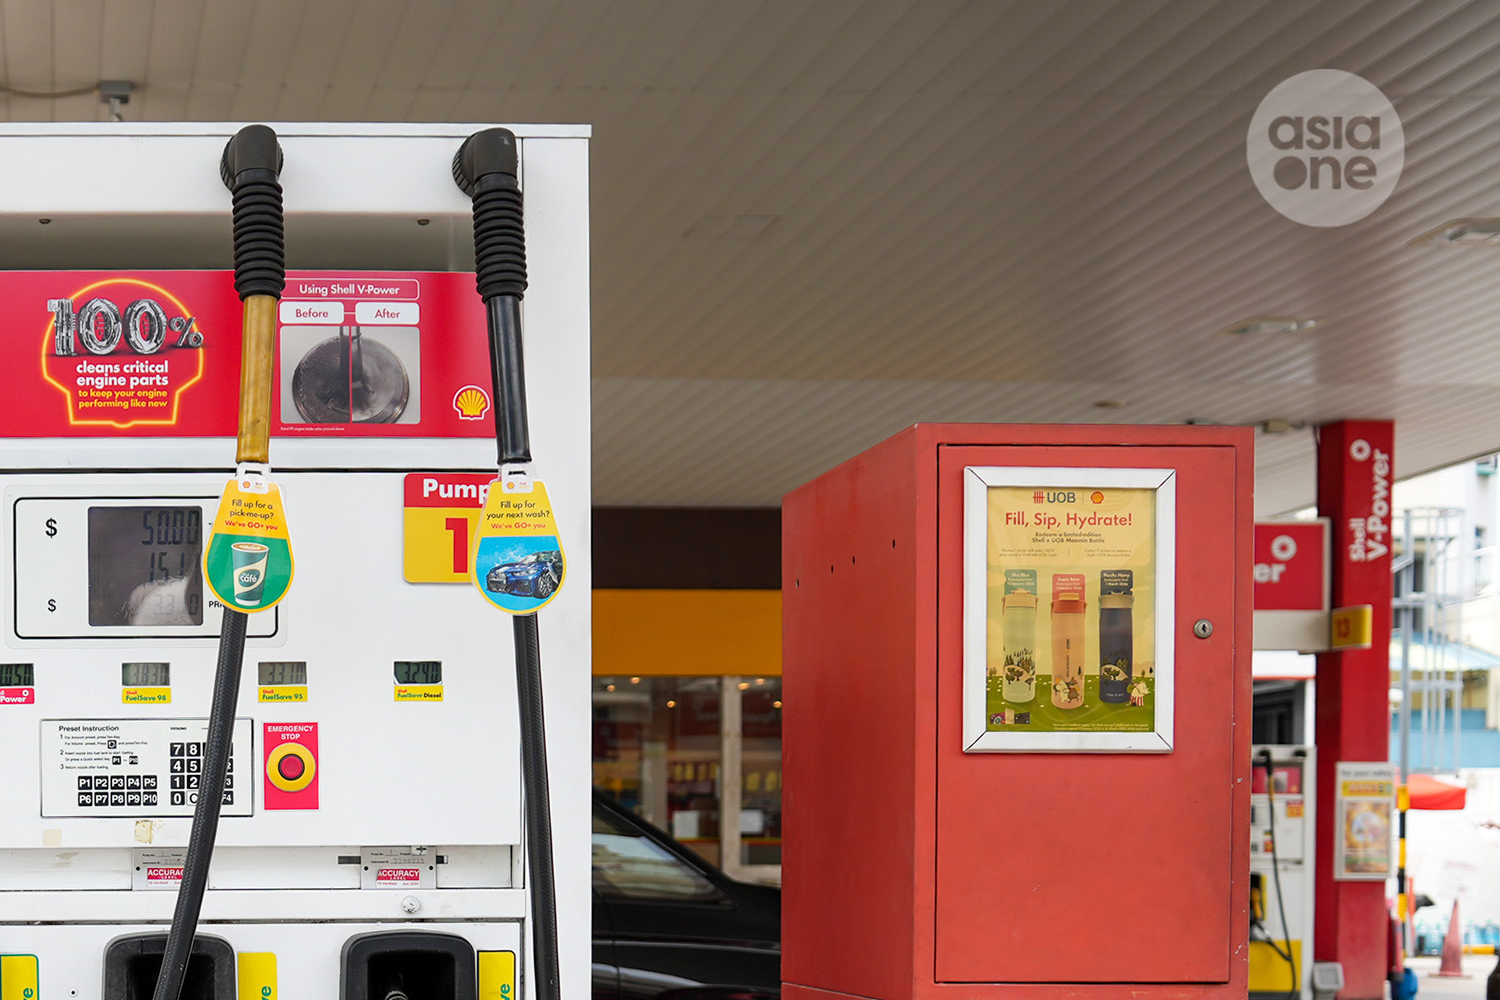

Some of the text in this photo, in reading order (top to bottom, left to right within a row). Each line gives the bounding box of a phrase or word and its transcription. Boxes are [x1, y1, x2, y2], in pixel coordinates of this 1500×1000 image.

[299, 284, 400, 296] Using Shell V-Power
[295, 309, 329, 319] Before
[374, 309, 400, 319] After
[47, 297, 204, 356] 100%
[76, 360, 169, 374] cleans critical
[76, 373, 169, 389] engine parts
[78, 389, 168, 399] to keep your engine
[78, 399, 168, 410] performing like new
[1047, 492, 1076, 504] UOB
[232, 499, 242, 507] Fill
[255, 501, 266, 509] for
[500, 501, 511, 509] Fill
[524, 500, 536, 508] for
[1367, 448, 1389, 562] V-Power
[229, 508, 274, 520] pick-me-up?
[486, 512, 504, 520] your
[525, 510, 550, 518] wash?
[225, 520, 246, 528] We've
[247, 521, 264, 529] GO+
[1005, 511, 1133, 530] Fill, Sip, Hydrate!
[45, 518, 58, 538] $
[533, 523, 546, 531] you
[445, 517, 468, 574] 1
[1350, 518, 1366, 562] Shell
[47, 599, 57, 612] $
[267, 725, 314, 733] EMERGENCY
[280, 733, 300, 741] STOP
[173, 744, 197, 755] 7 8
[173, 761, 197, 772] 4 5
[79, 778, 156, 788] P1 P2 P3 P4 P5
[174, 777, 198, 788] 1 2
[79, 794, 157, 804] P6 P7 P8 P9 P10
[174, 793, 181, 804] 0
